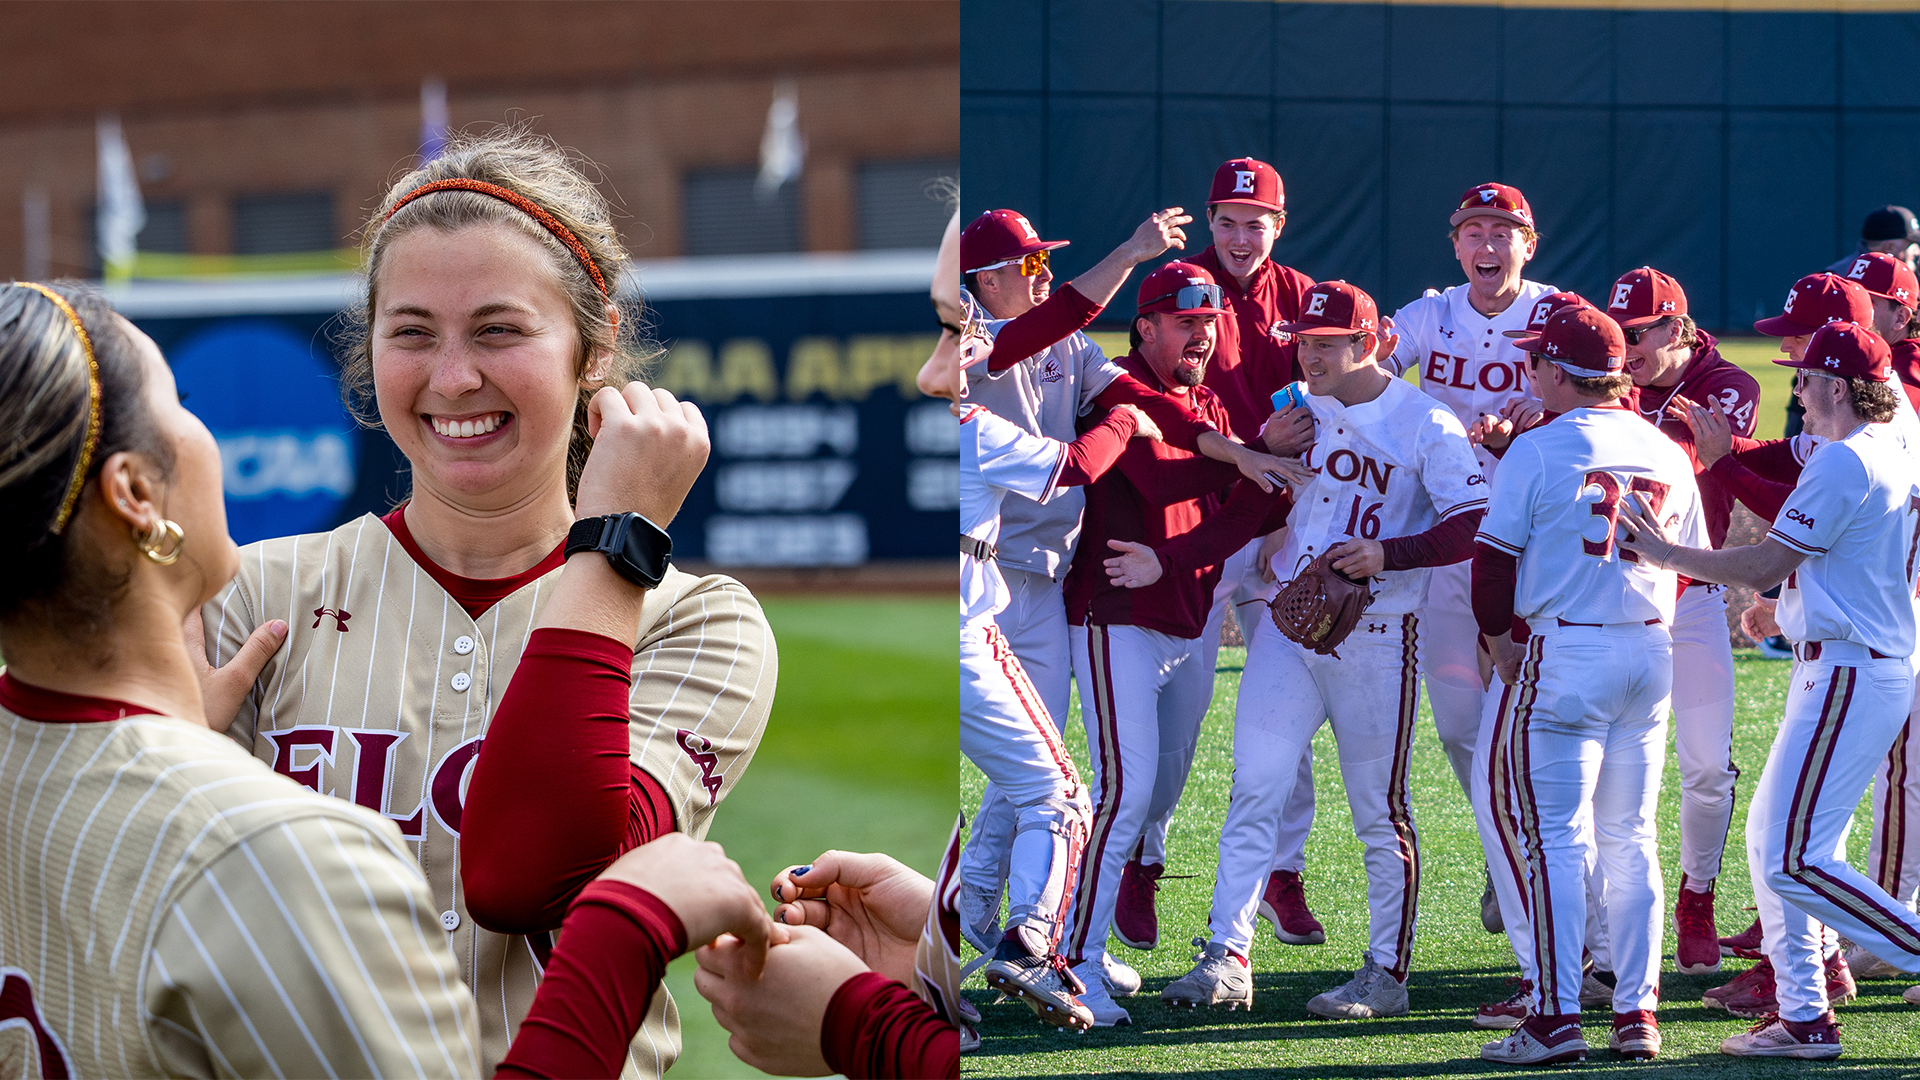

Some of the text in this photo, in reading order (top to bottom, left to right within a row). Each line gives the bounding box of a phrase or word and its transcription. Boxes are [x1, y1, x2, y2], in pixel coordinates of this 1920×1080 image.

[1231, 170, 1255, 194] E
[1847, 258, 1871, 280] E
[1305, 292, 1329, 317] E
[1610, 283, 1634, 309] E
[1783, 288, 1798, 314] E
[1530, 302, 1553, 325] E
[1709, 388, 1754, 430] 34
[219, 428, 357, 499] CAA
[1306, 442, 1397, 496] LON
[1343, 493, 1384, 540] 16
[1580, 470, 1672, 565] 37
[1785, 508, 1816, 531] CAA
[674, 727, 725, 808] CAA
[1549, 1023, 1573, 1038] UNDER
